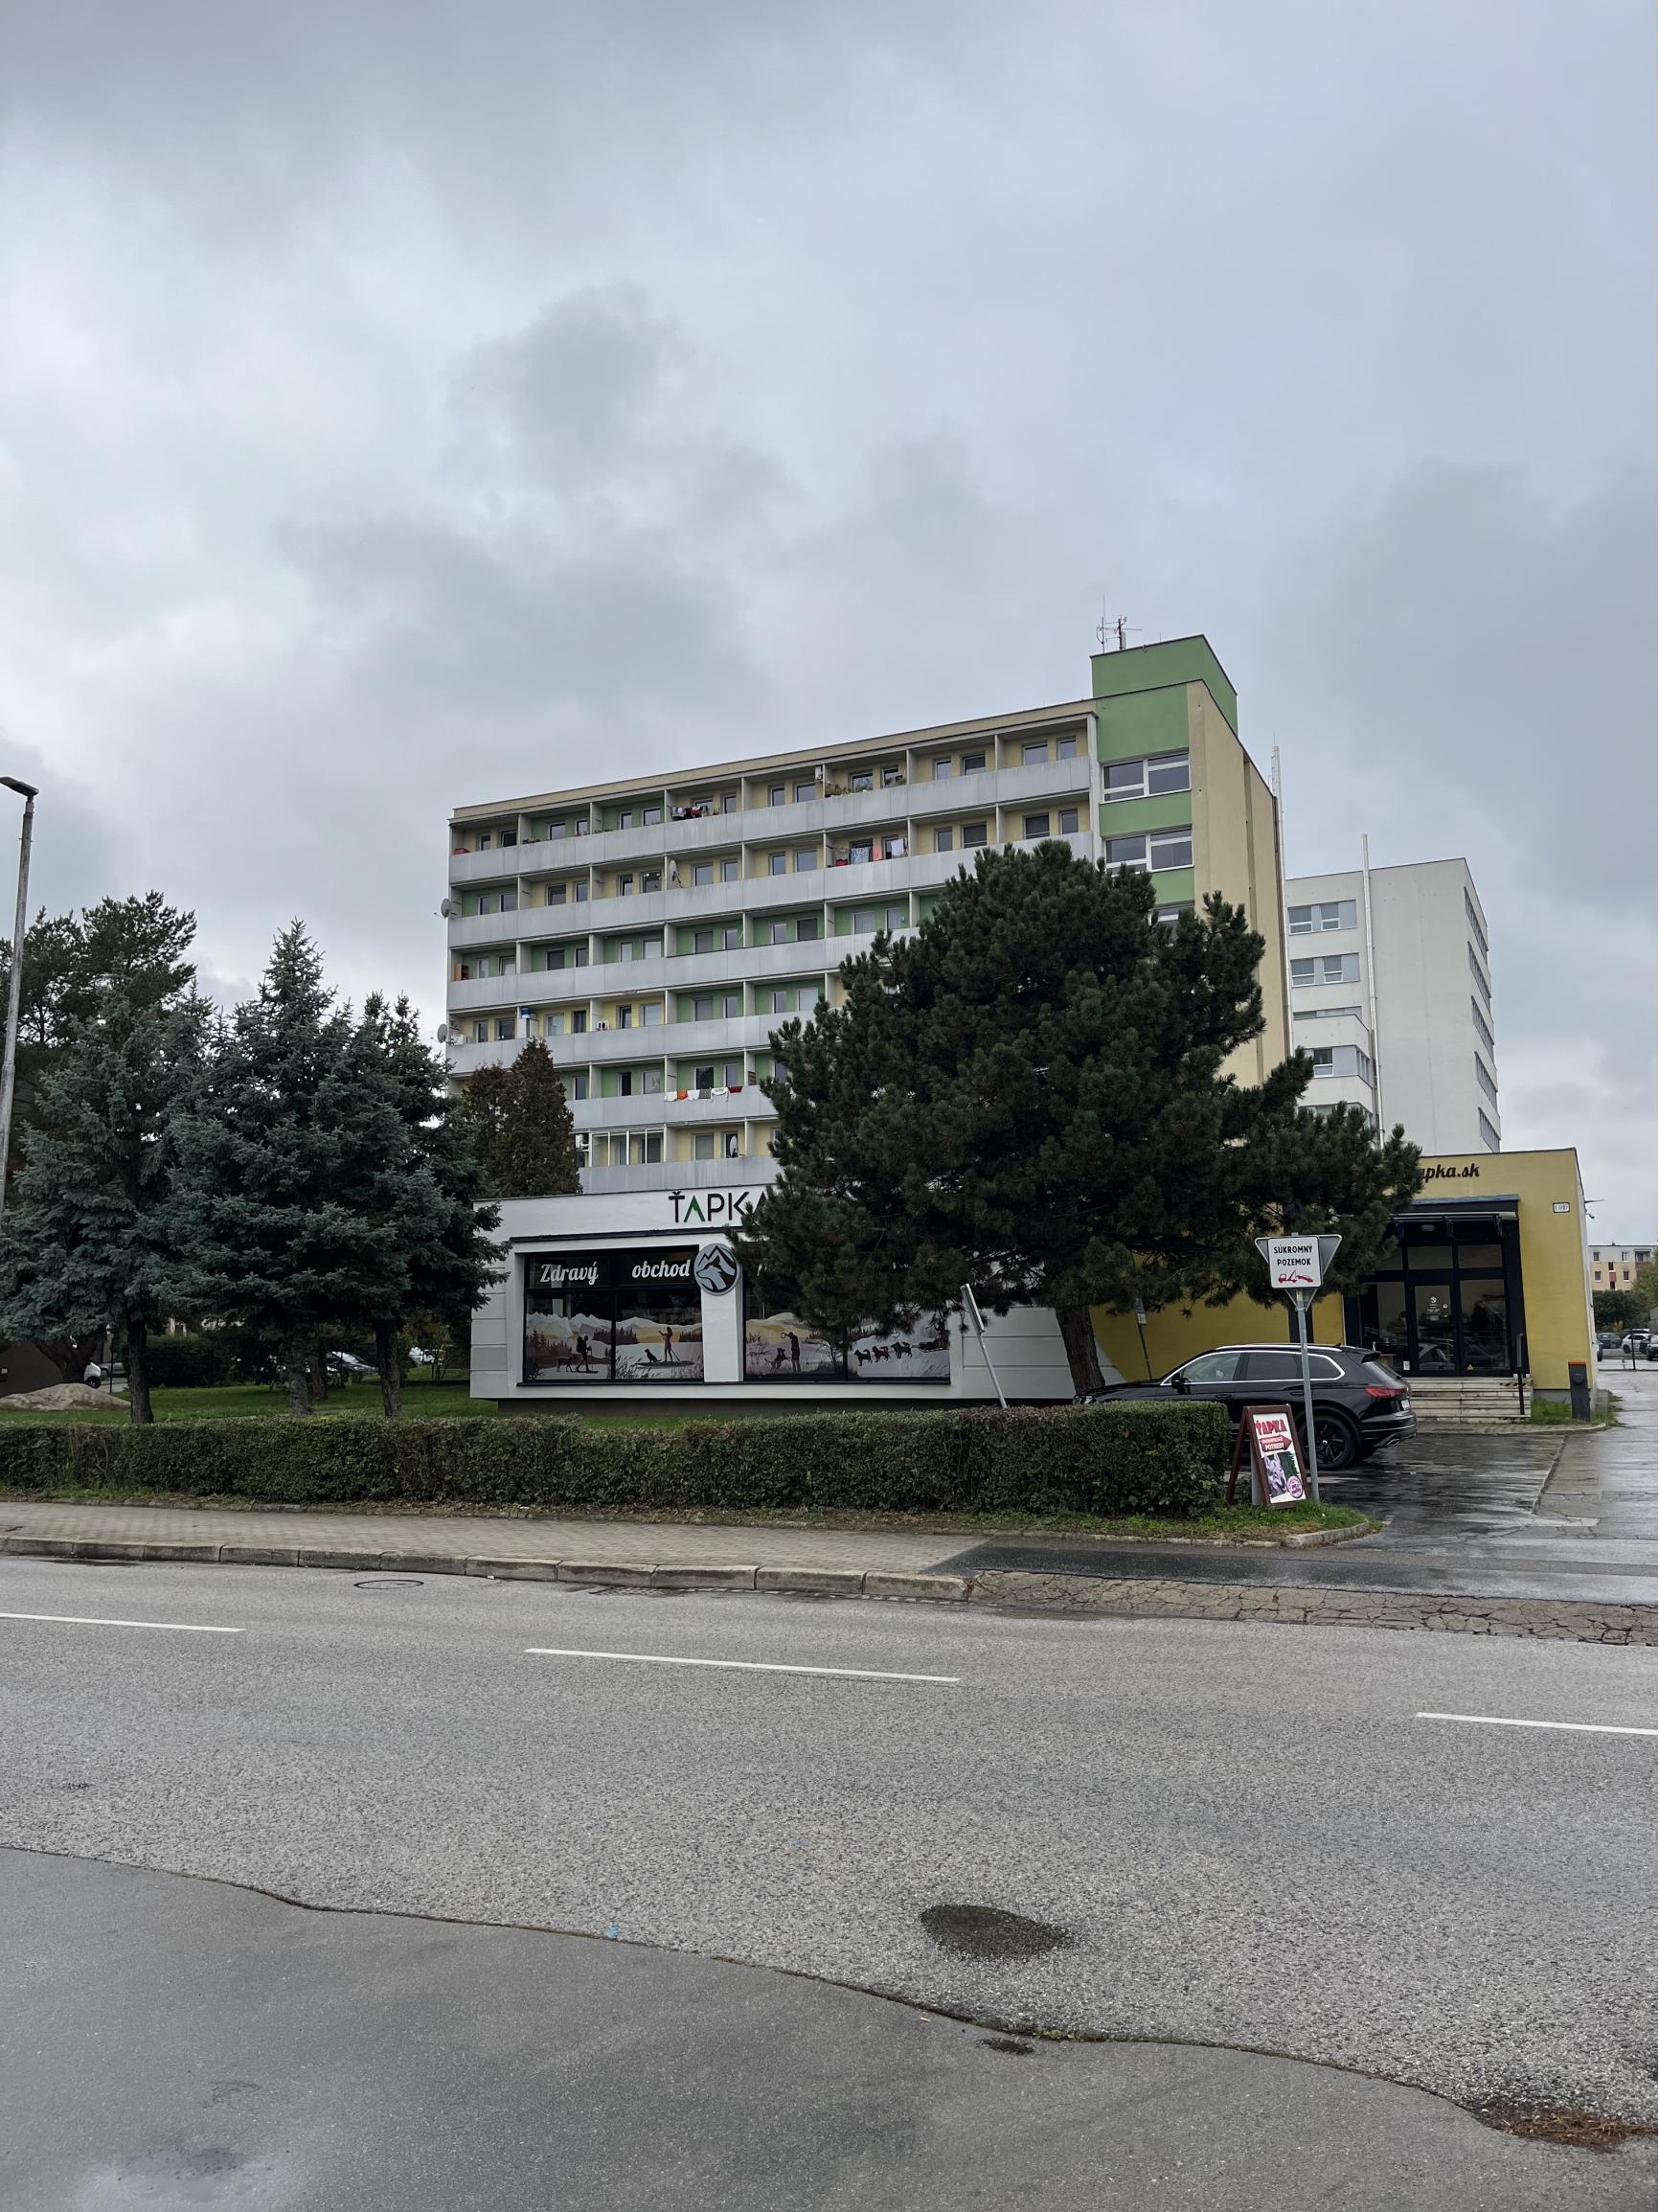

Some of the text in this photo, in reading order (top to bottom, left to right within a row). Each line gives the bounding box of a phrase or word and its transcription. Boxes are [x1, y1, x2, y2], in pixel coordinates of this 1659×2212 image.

[1273, 1243, 1313, 1254] SÚKROMNÝ
[1277, 1258, 1311, 1266] POZEMOK
[540, 1259, 691, 1286] Zdravý obchod
